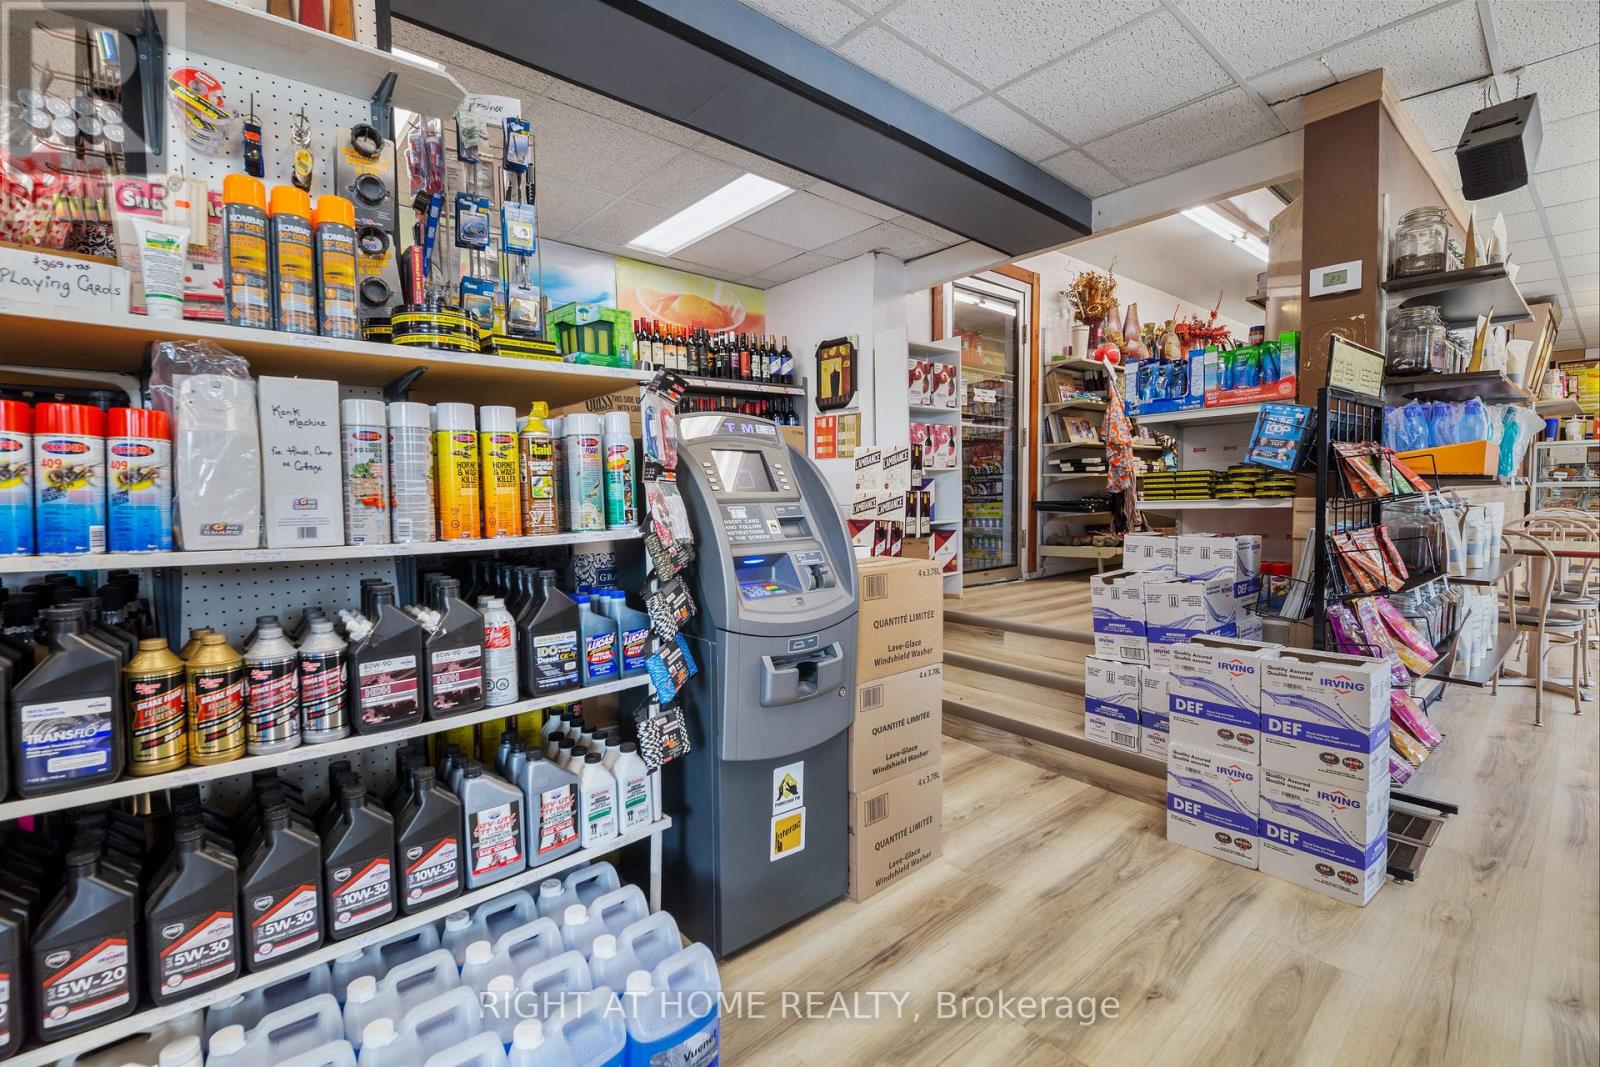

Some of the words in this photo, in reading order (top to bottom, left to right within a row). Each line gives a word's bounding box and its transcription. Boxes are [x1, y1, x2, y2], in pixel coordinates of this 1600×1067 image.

[229, 213, 265, 227] KOMBAT
[278, 223, 310, 236] KOMBAT
[321, 232, 353, 244] KOMBAT
[531, 444, 552, 456] Raid
[41, 459, 62, 469] 409
[111, 461, 127, 470] 409
[873, 614, 908, 630] QUANTITÉ
[909, 610, 935, 622] LIMITÉE
[588, 634, 615, 651] LUCAS
[623, 629, 649, 646] LUCAS
[887, 639, 922, 653] Lave-Glace
[537, 655, 559, 664] Diesel
[874, 651, 910, 667] Windshield
[911, 647, 933, 658] Washer
[1174, 650, 1191, 658] Quality
[1218, 662, 1255, 674] IRVING
[1267, 665, 1288, 673] Quality
[1289, 668, 1314, 676] Assured
[1319, 678, 1365, 692] IRVING
[1175, 698, 1204, 715] DEF
[872, 718, 906, 736] QUANTITÉ
[906, 711, 931, 725] LIMITÉE
[1268, 718, 1303, 736] DEF
[26, 726, 97, 745] TRANSFLO
[886, 744, 919, 761] Lave-Glace
[1172, 749, 1190, 758] Quality
[872, 756, 907, 776] Windshield
[908, 750, 929, 763] Washer
[1216, 765, 1254, 781] IRVING
[1266, 771, 1286, 782] Quality
[1287, 777, 1311, 788] Assured
[1173, 797, 1202, 816] DEF
[1317, 791, 1361, 809] IRVING
[874, 826, 908, 851] QUANTITÉ
[909, 815, 934, 835] LIMITÉE
[1267, 823, 1300, 845] DEF
[888, 847, 921, 869] Lave-Glace
[415, 861, 456, 882] 10W-30
[875, 863, 910, 887] Windshield
[911, 851, 932, 868] Washer
[343, 882, 389, 906] 10W-30
[265, 911, 314, 936] 5W-30
[174, 939, 230, 967] 5W-30
[57, 966, 127, 998] 5W-20
